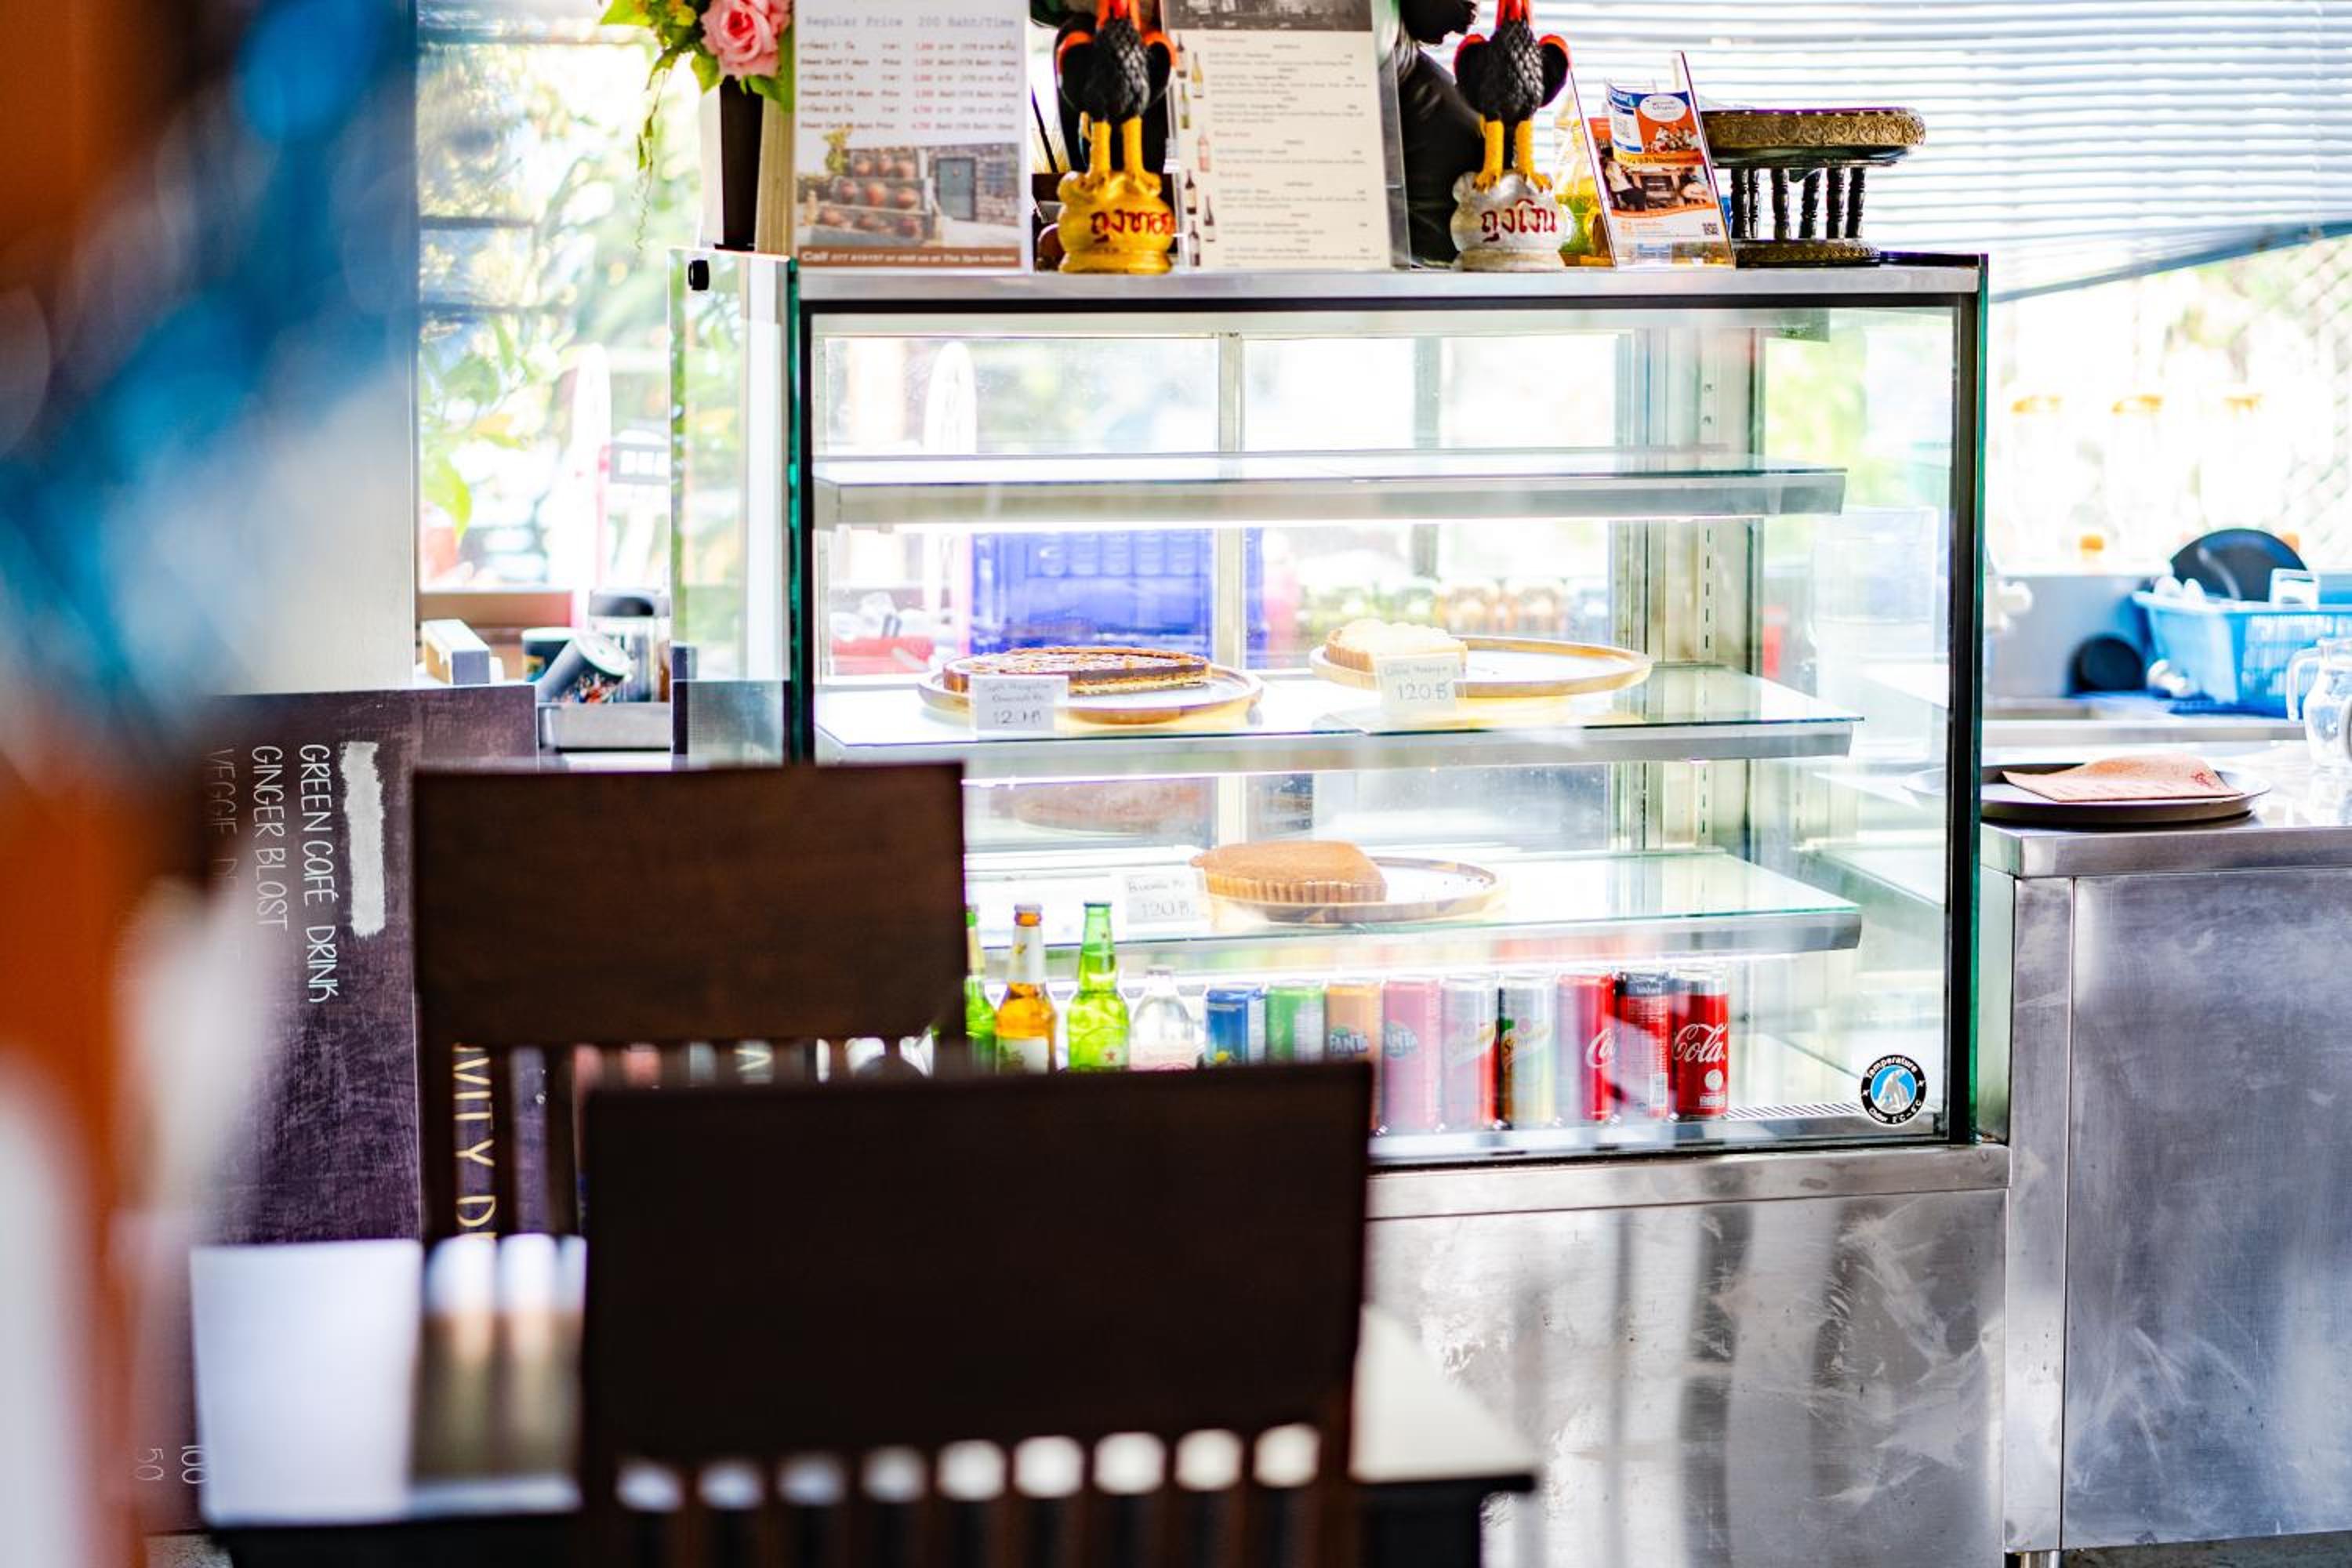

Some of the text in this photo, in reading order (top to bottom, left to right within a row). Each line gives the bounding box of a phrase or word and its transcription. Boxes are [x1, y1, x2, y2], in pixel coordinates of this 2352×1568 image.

[251, 746, 285, 838] GINGER
[299, 744, 332, 832] GREEN
[306, 924, 339, 1004] DRINK
[1867, 1057, 1918, 1080] Temperature
[181, 1444, 209, 1484] 100
